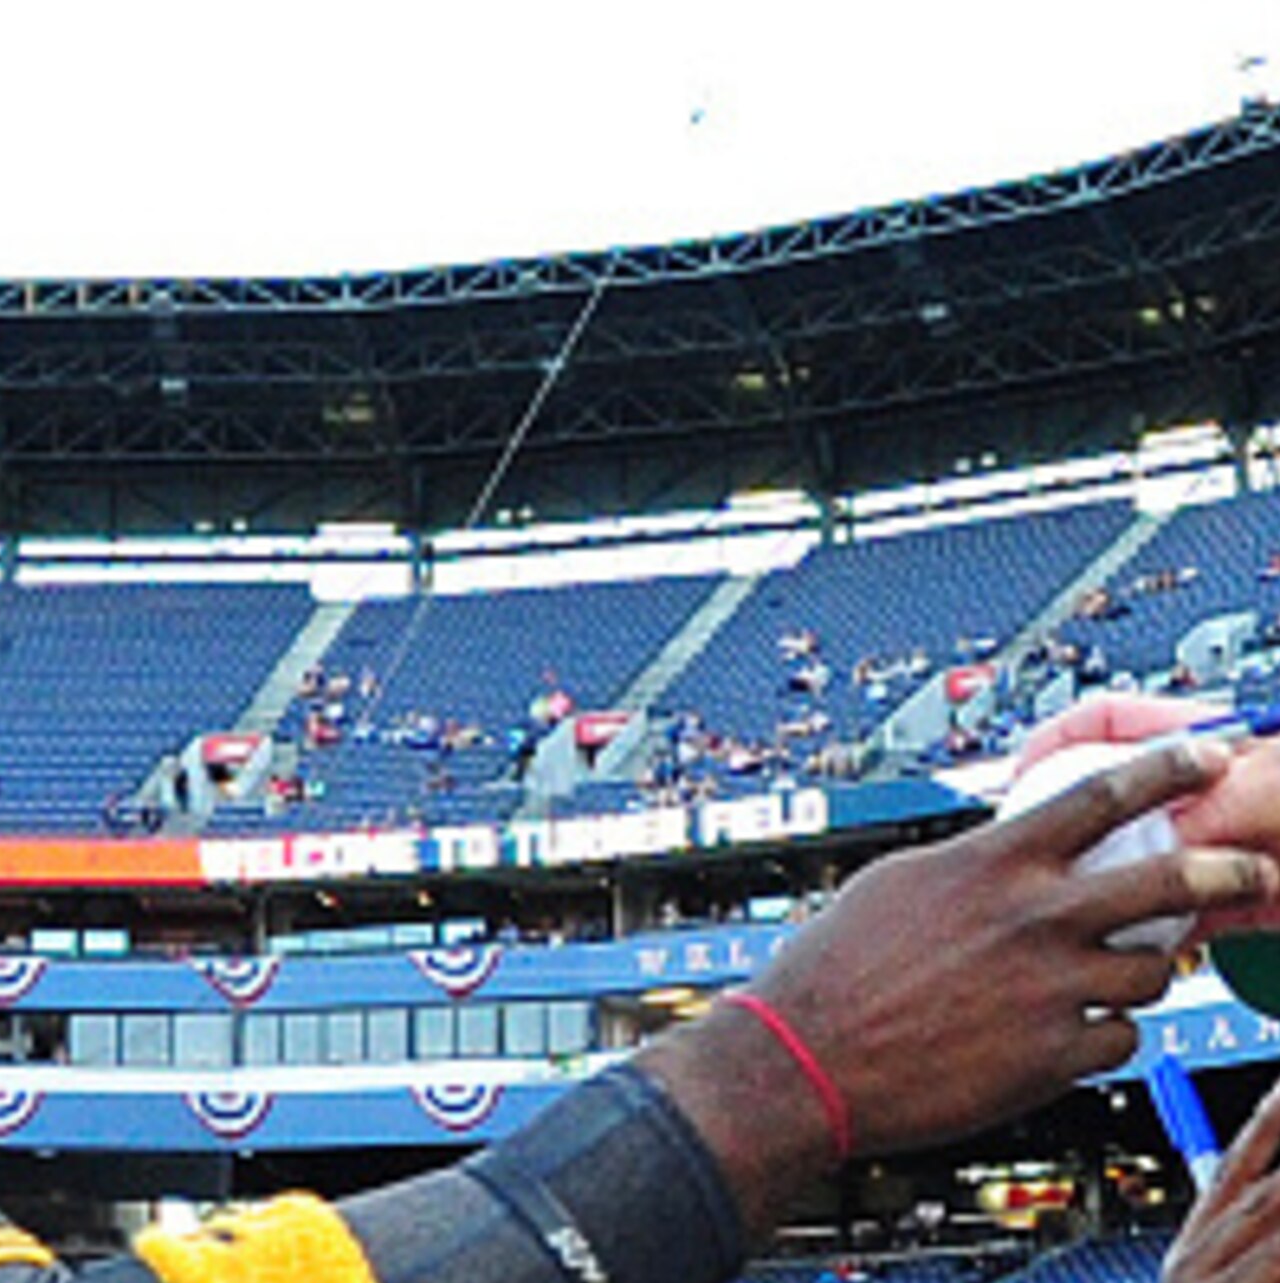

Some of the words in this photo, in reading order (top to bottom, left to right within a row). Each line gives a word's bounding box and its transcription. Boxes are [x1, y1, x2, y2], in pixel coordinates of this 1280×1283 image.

[200, 832, 418, 879] WELCOME
[430, 826, 496, 872] TO
[510, 806, 688, 867] TURNER
[700, 786, 827, 847] FIELD
